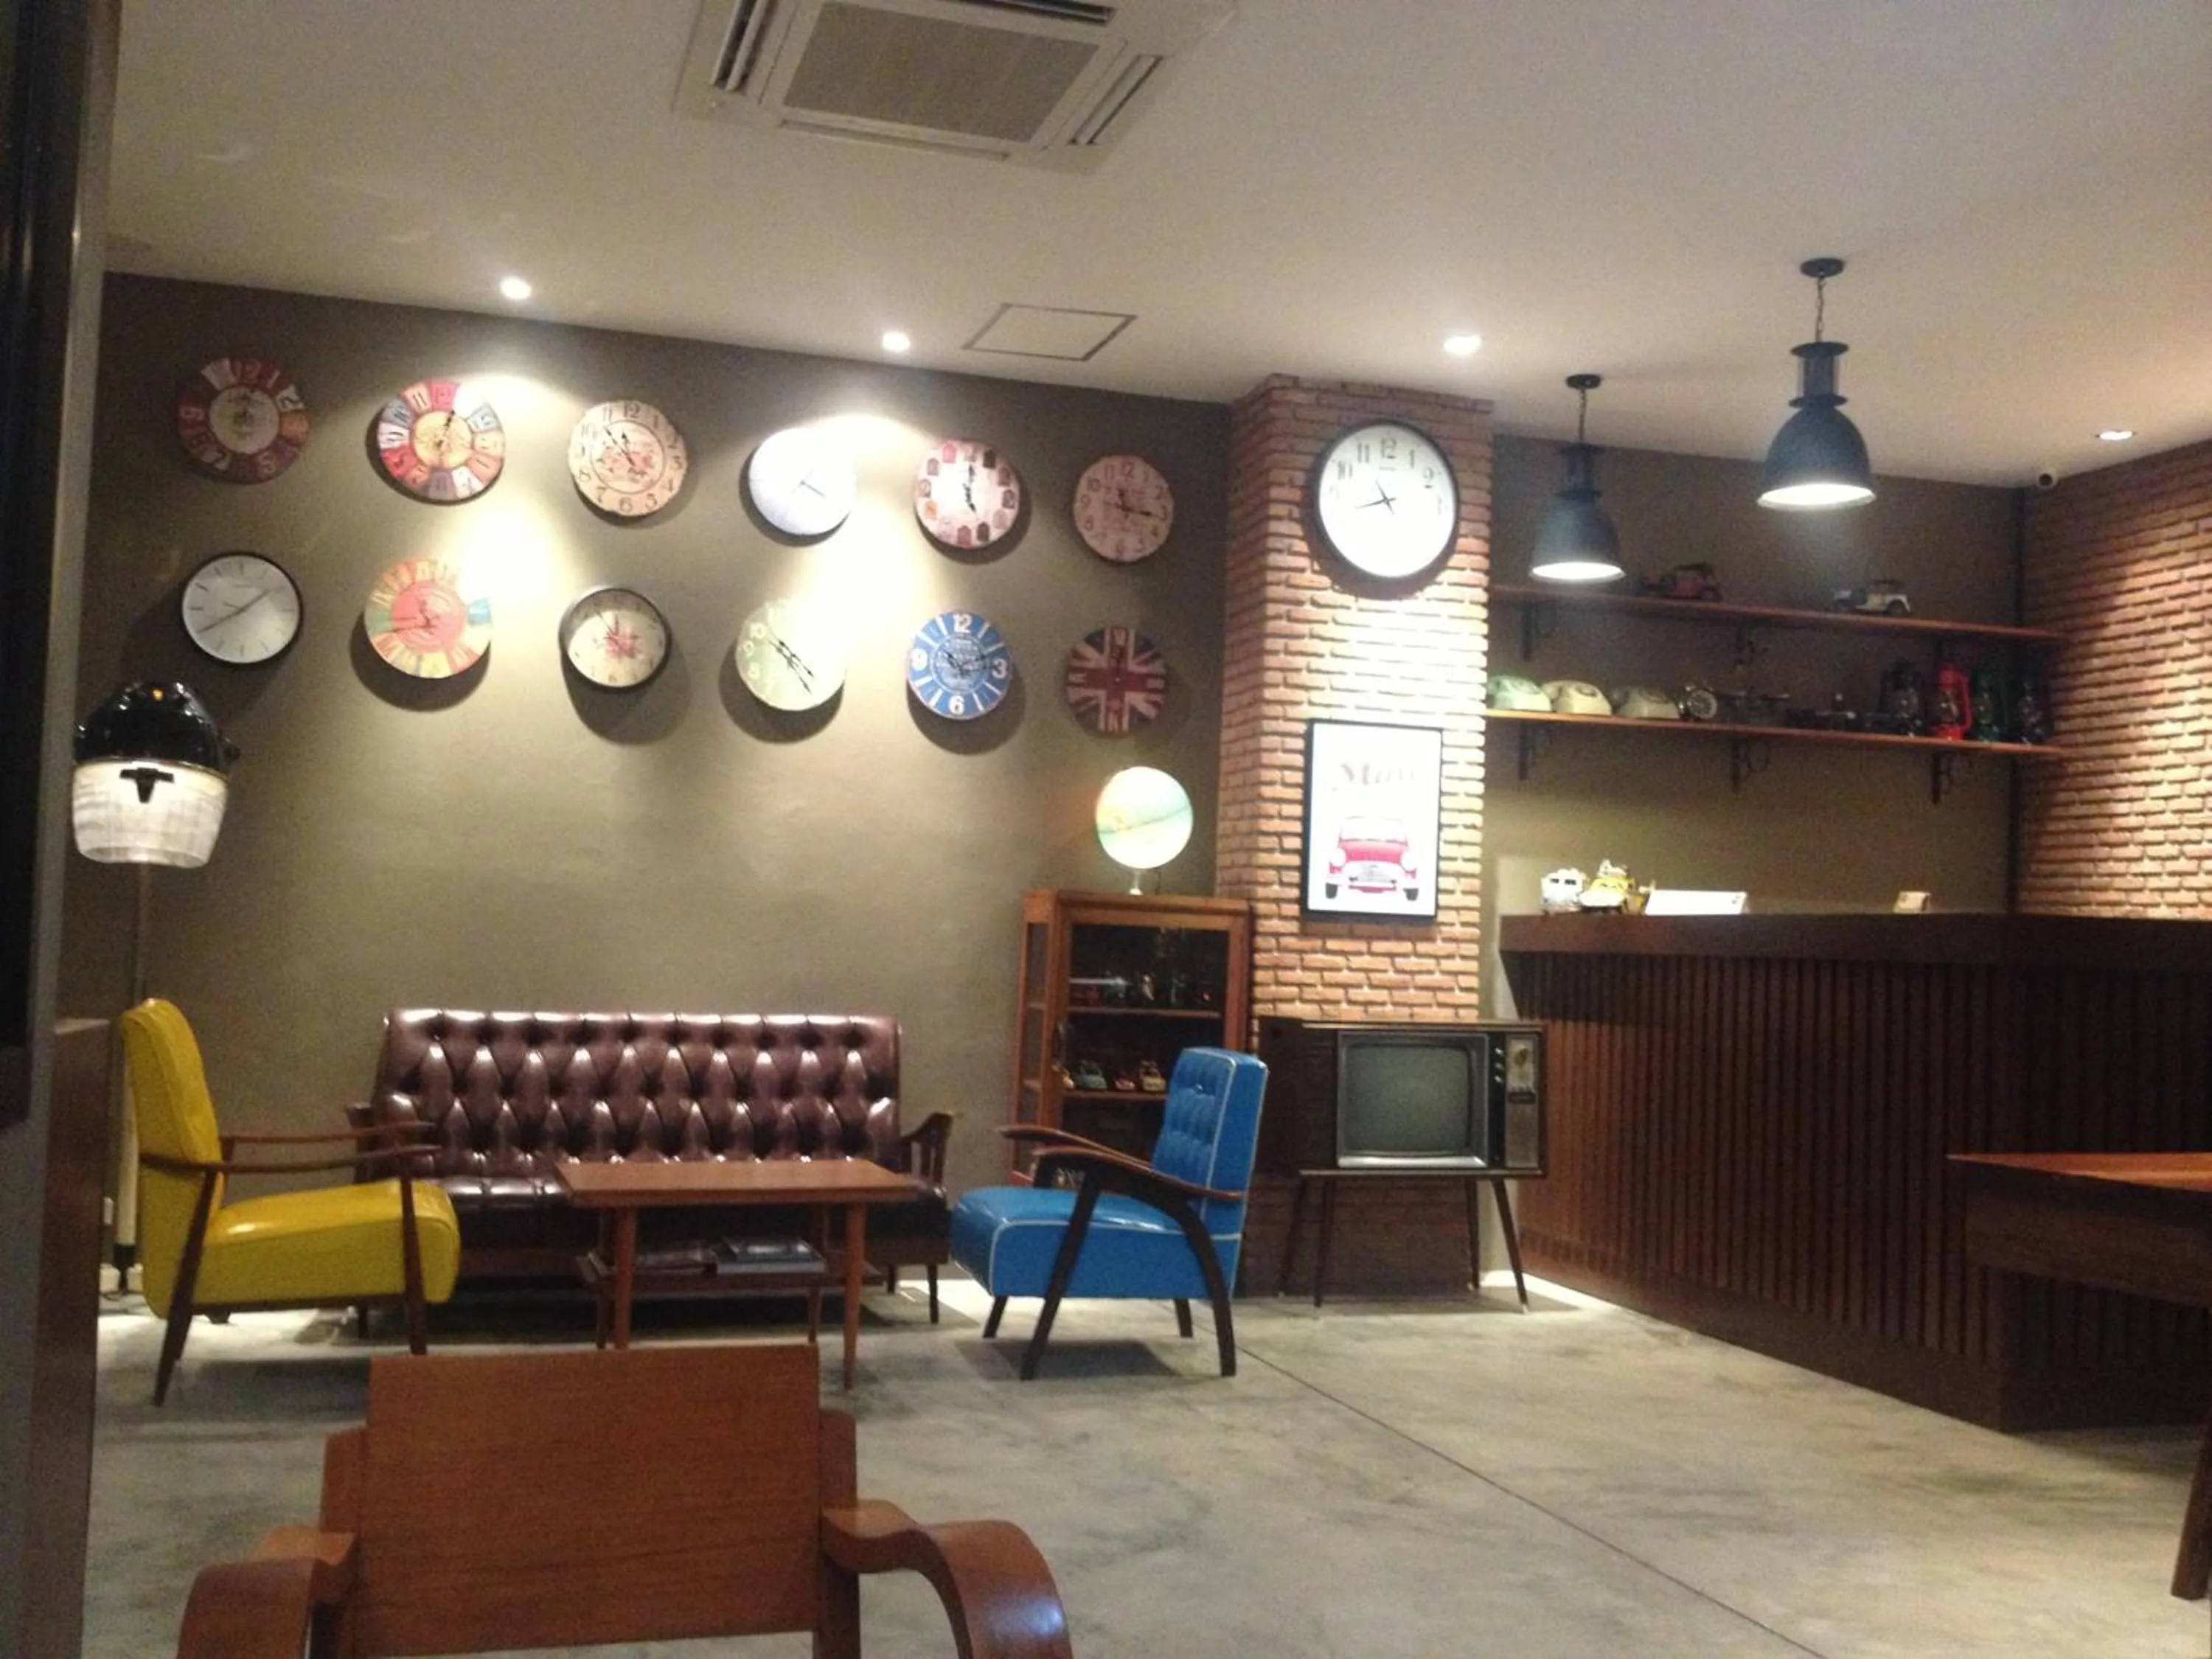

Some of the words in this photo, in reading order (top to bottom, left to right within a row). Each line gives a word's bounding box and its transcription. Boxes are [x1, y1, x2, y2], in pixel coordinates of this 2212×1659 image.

[624, 403, 641, 419] 12
[1357, 442, 1370, 465] 11
[1380, 436, 1398, 460] 12
[1408, 448, 1416, 470] 1
[1121, 460, 1135, 480] 12
[1422, 466, 1436, 490] 2
[619, 495, 633, 513] 6
[952, 613, 973, 634] 12
[991, 656, 1009, 680] 3
[948, 694, 966, 716] 6
